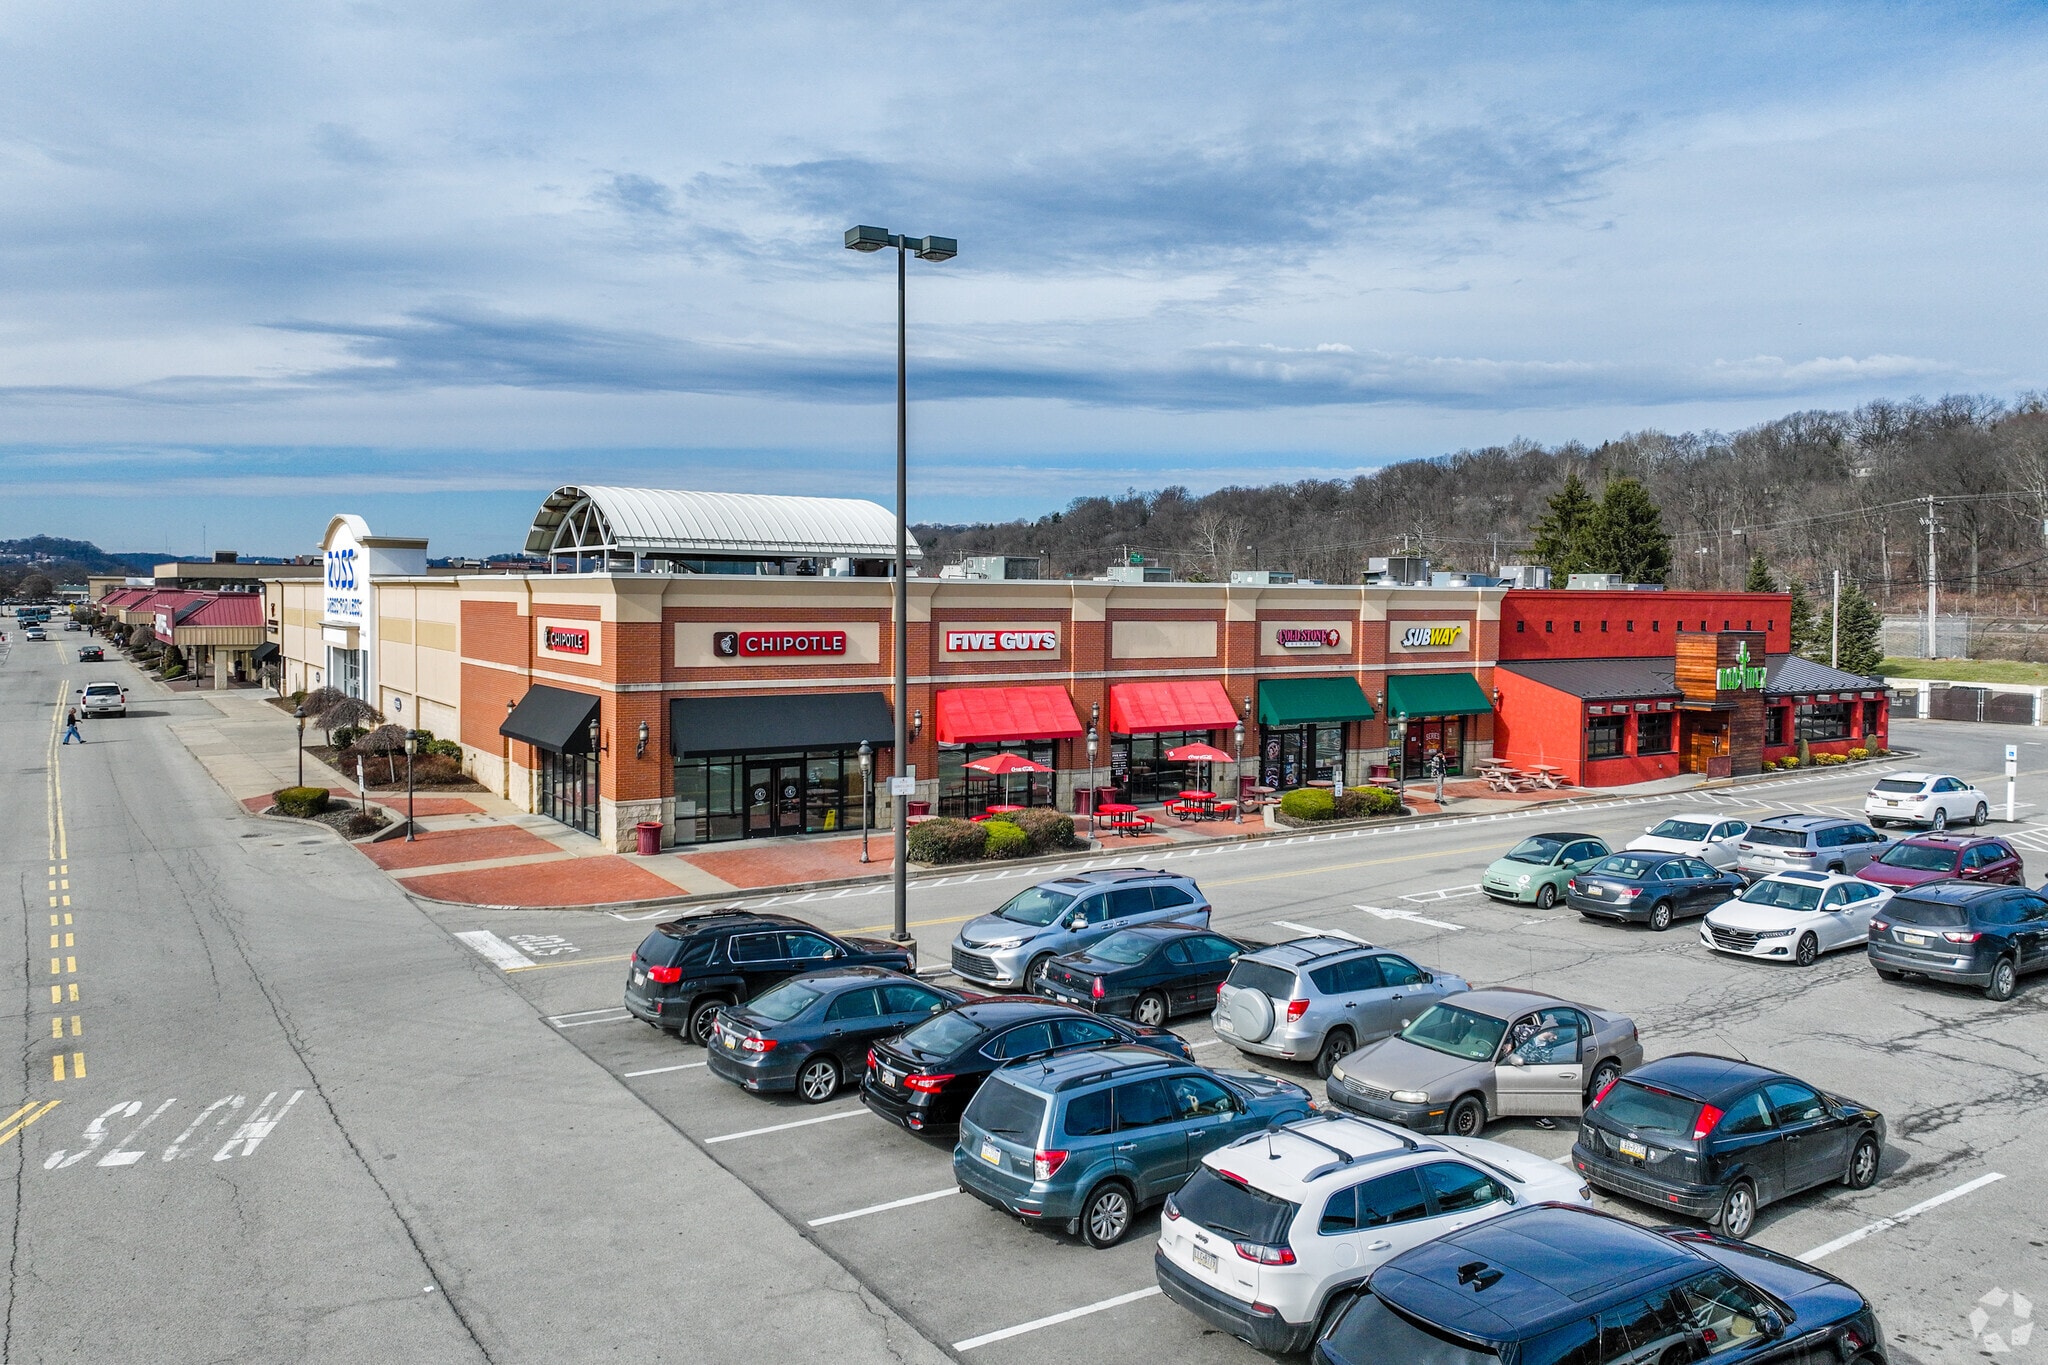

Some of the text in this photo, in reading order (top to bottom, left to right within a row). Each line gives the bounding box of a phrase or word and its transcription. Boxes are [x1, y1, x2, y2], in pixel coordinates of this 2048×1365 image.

[551, 632, 583, 648] CHIPOTLE
[746, 636, 843, 652] CHIPOTLE
[948, 632, 1055, 650] FIVE GUYS
[1278, 629, 1328, 645] COLD STONE
[1402, 626, 1462, 647] SUBWAY
[43, 1089, 305, 1170] SLOW
